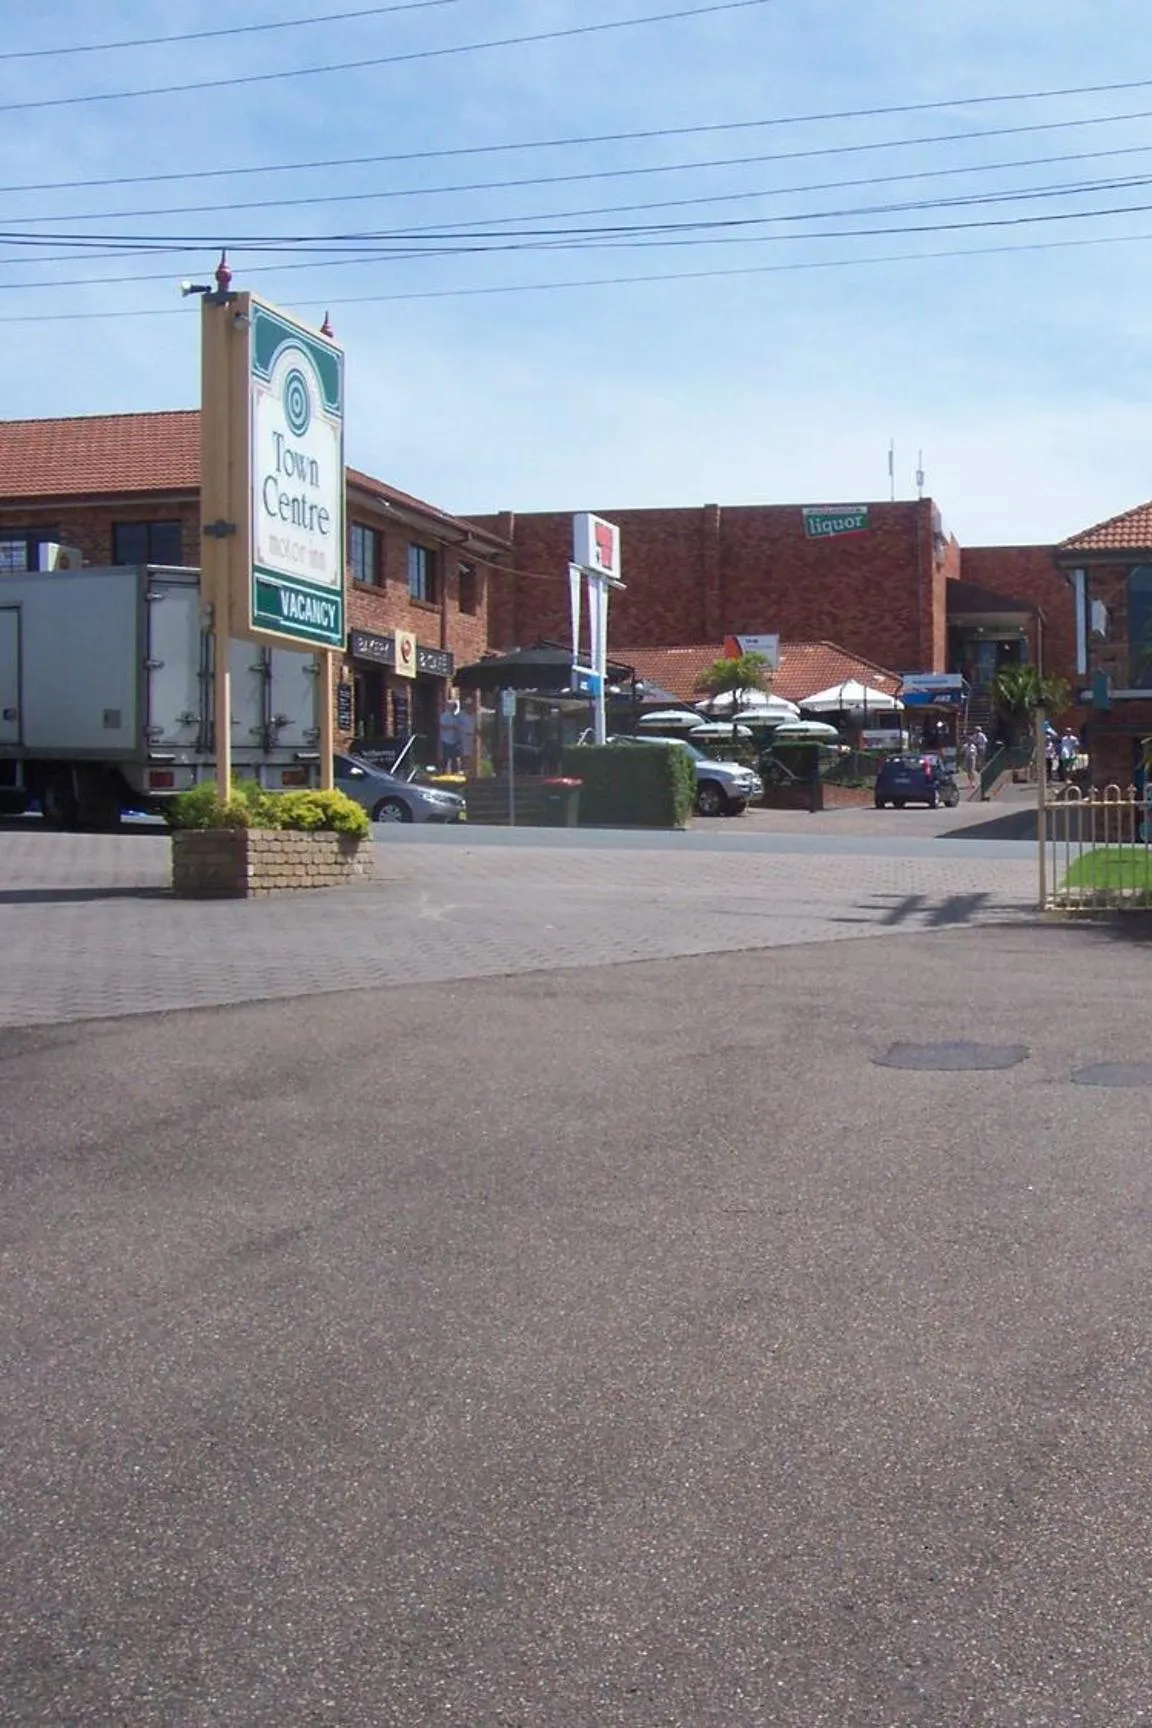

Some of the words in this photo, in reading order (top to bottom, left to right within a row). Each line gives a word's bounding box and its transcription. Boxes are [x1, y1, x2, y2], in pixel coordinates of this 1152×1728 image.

[272, 431, 320, 489] Town
[262, 474, 330, 536] Centre
[808, 515, 864, 537] liquor
[279, 588, 337, 629] VACANCY
